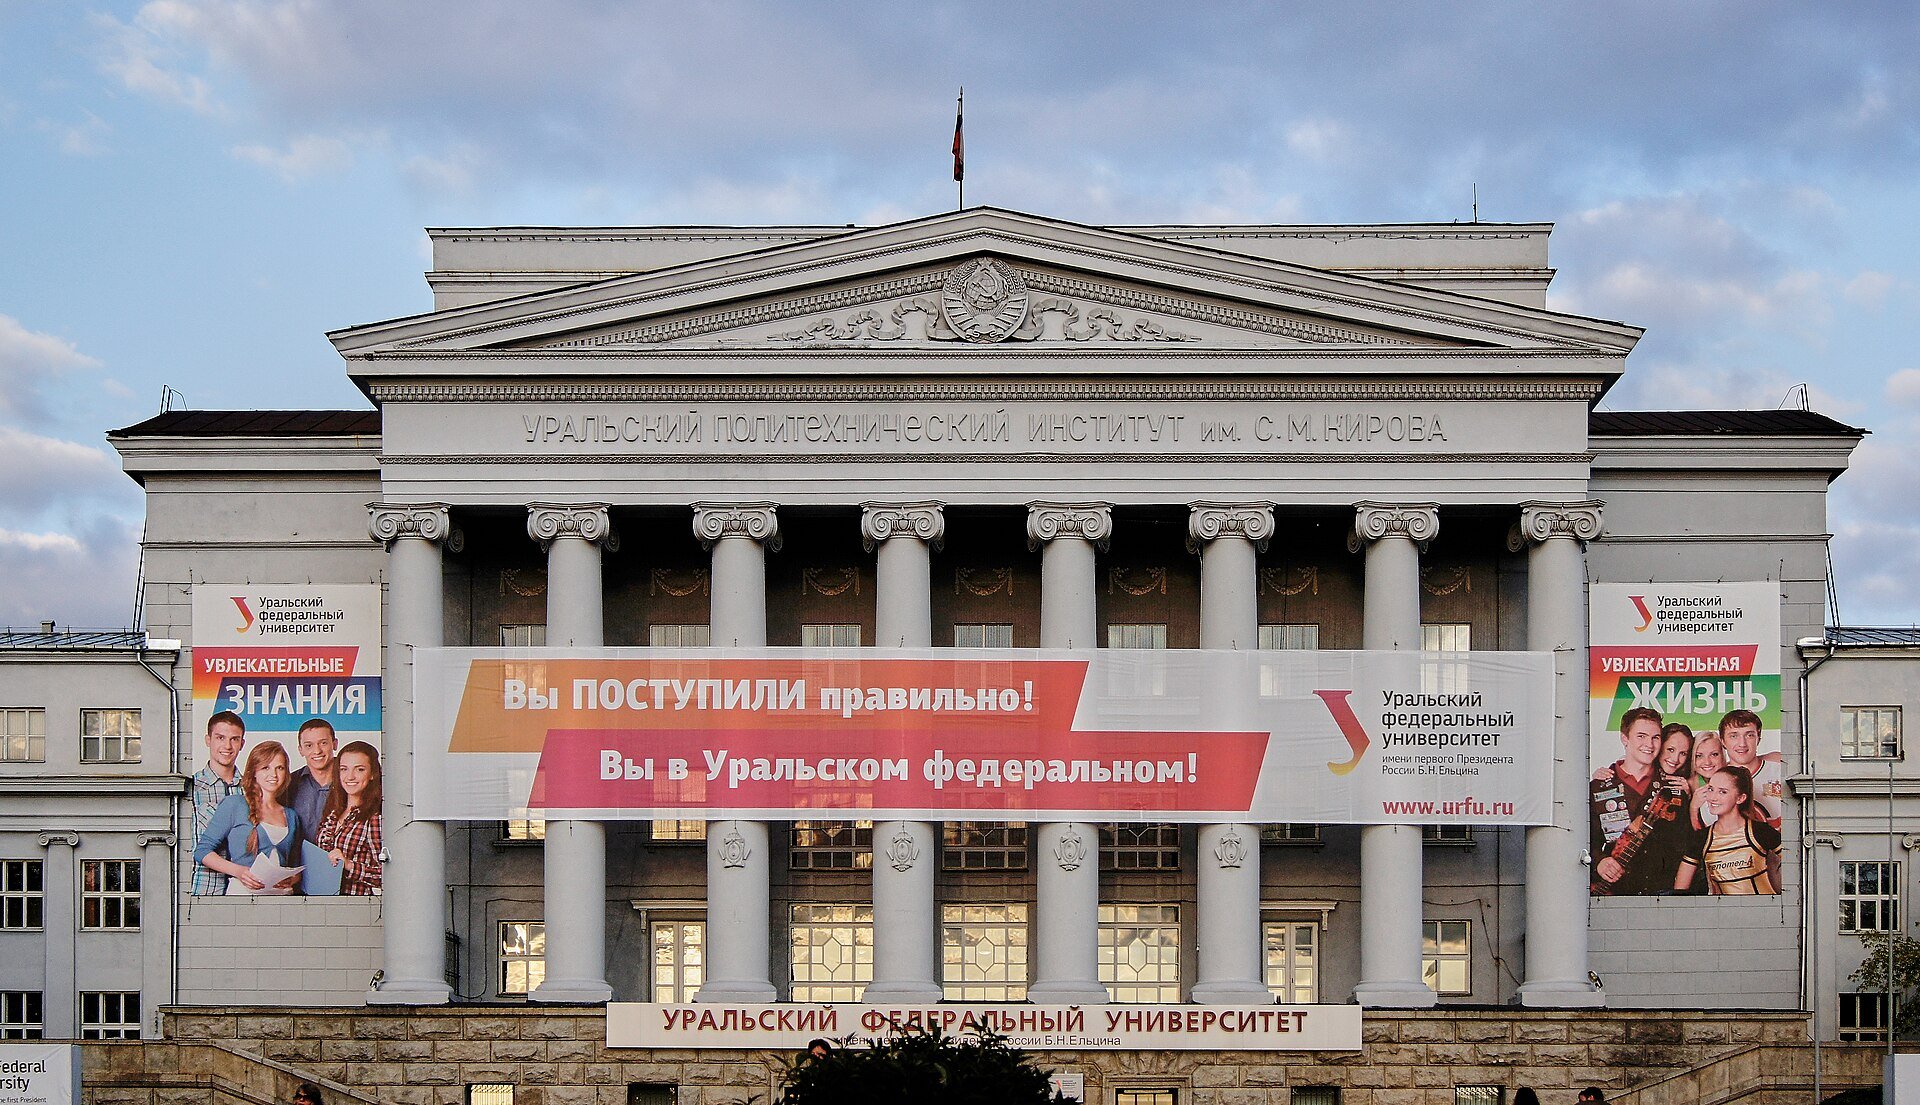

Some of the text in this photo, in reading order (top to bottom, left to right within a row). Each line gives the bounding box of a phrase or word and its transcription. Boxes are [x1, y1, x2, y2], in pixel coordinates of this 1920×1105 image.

[523, 410, 702, 443] УРАЛЬСКИЙ
[1028, 413, 1185, 443] ИНСТИТУТ
[258, 596, 323, 610] Уральский
[1656, 595, 1722, 608] Уральский
[258, 609, 344, 623] федеральный
[1656, 608, 1743, 621] федеральный
[258, 623, 336, 636] университет
[1656, 622, 1735, 635] университет
[204, 657, 344, 674] УВЛЕКАТЕЛЬНЫЕ
[1601, 656, 1740, 673] УВЛЕКАТЕЛЬНАЯ
[225, 684, 366, 716] ЗНАНИЯ
[503, 678, 1034, 719] Вы ПОСТУПИЛИ правильно!
[1382, 690, 1482, 710] Уральский
[1626, 680, 1767, 715] ЖИЗНЬ
[1381, 711, 1515, 730] федеральный
[1381, 732, 1501, 750] университет
[1382, 753, 1514, 766] имени первого Президента
[600, 750, 1198, 790] Вы в Уральском федеральном!
[1382, 765, 1415, 775] России
[1382, 797, 1514, 816] www.urfu.ru
[662, 1005, 1308, 1033] УРАЛЬСКИЙ ФЕДЕРАЛЬНЫЙ УНИВЕРСИТЕТ
[1001, 1036, 1041, 1046] оссии
[0, 1060, 47, 1073] ederal
